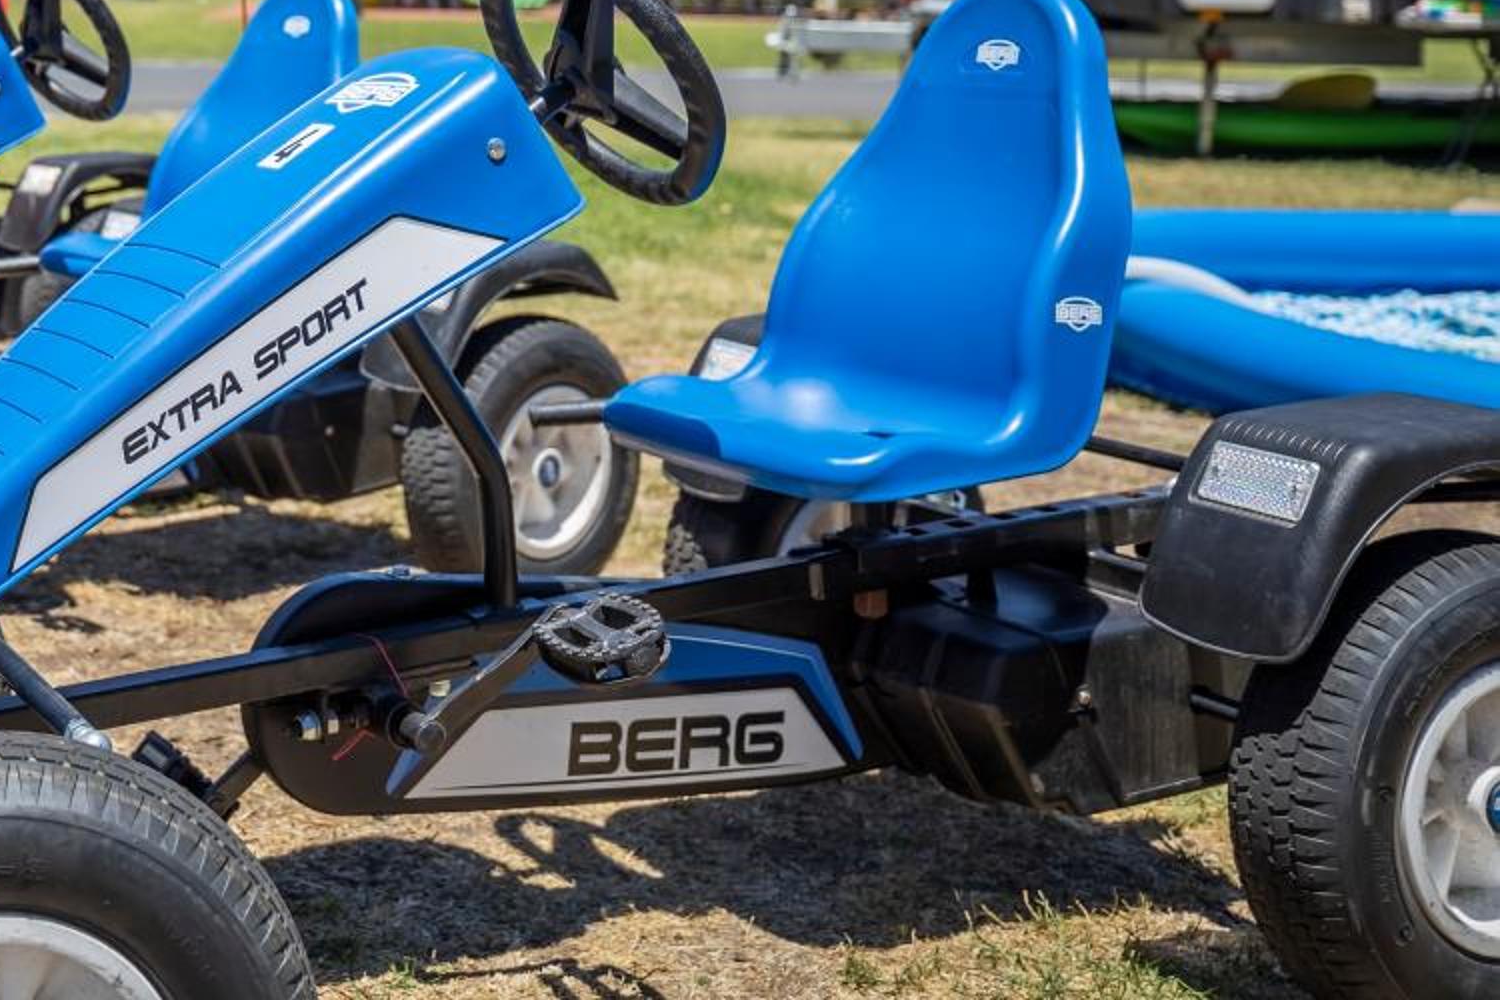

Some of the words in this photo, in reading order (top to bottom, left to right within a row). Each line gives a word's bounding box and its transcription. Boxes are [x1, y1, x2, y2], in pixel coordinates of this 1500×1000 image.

[122, 370, 243, 465] EXTRA
[253, 277, 367, 381] SPORT
[568, 711, 785, 776] BERG
